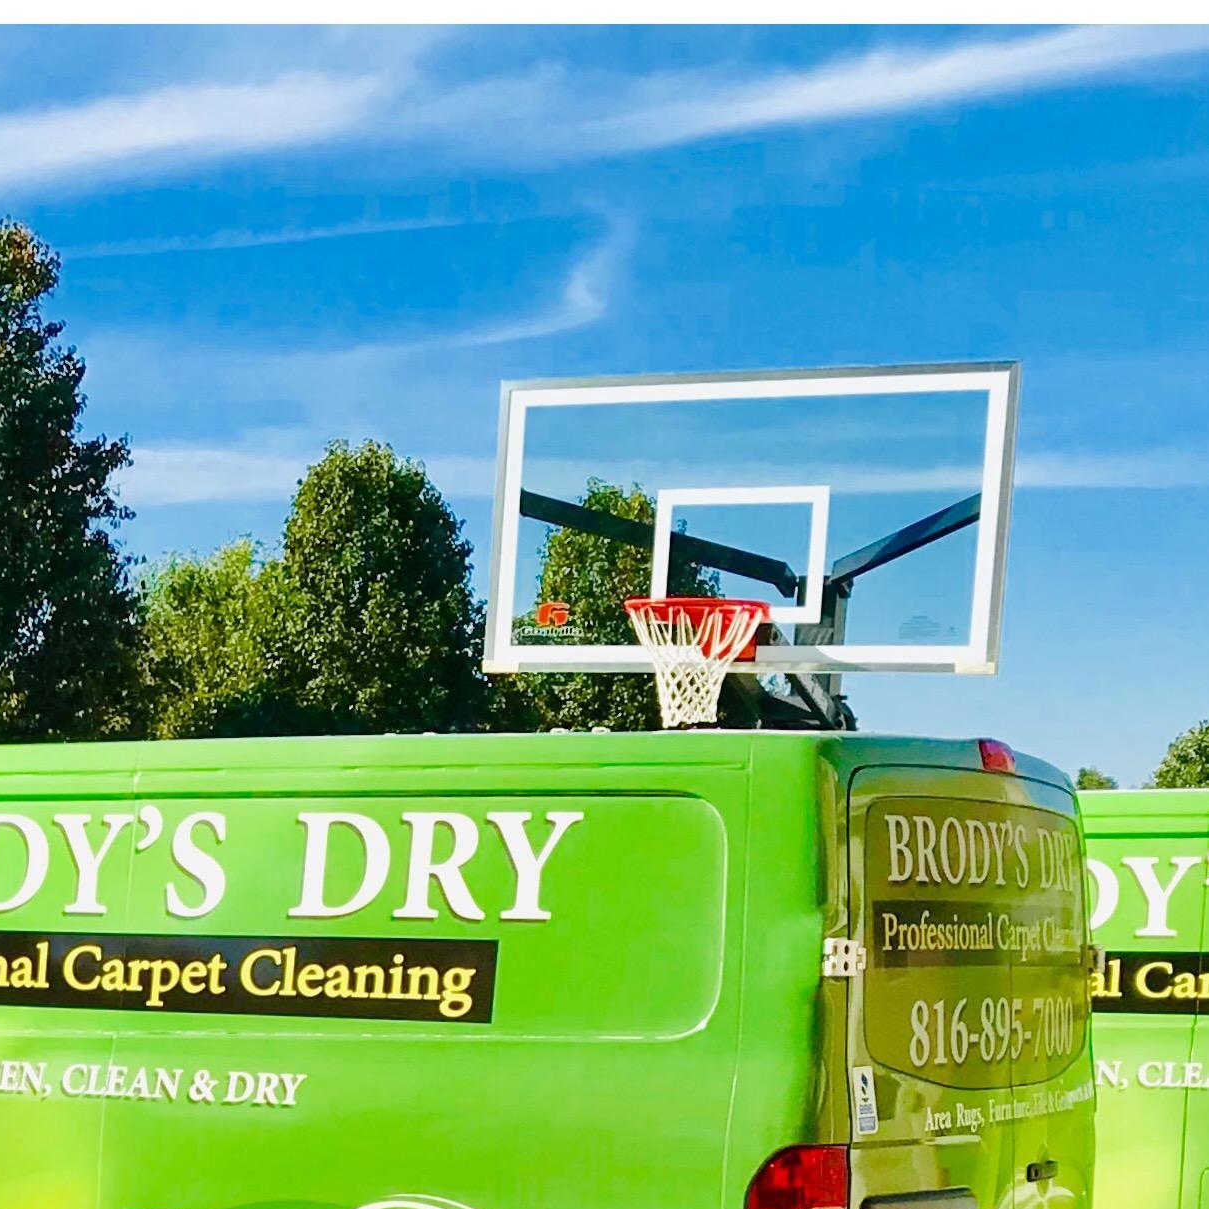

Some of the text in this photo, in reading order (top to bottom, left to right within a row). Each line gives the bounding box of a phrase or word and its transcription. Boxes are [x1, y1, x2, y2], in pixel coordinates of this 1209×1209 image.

[287, 811, 584, 921] DRY
[884, 814, 1074, 891] BRODY'S DRY
[882, 910, 994, 951] Professional
[997, 914, 1041, 962] Carpet
[62, 945, 227, 1007] Carpet
[239, 946, 476, 1018] Cleaning
[909, 996, 1074, 1068] 816-895-7000
[61, 1063, 183, 1101] CLEAN
[190, 1069, 216, 1102] &
[223, 1071, 308, 1106] DRY
[1136, 1061, 1209, 1089] CLE
[924, 1107, 952, 1132] Area
[956, 1103, 985, 1132] Rugs,
